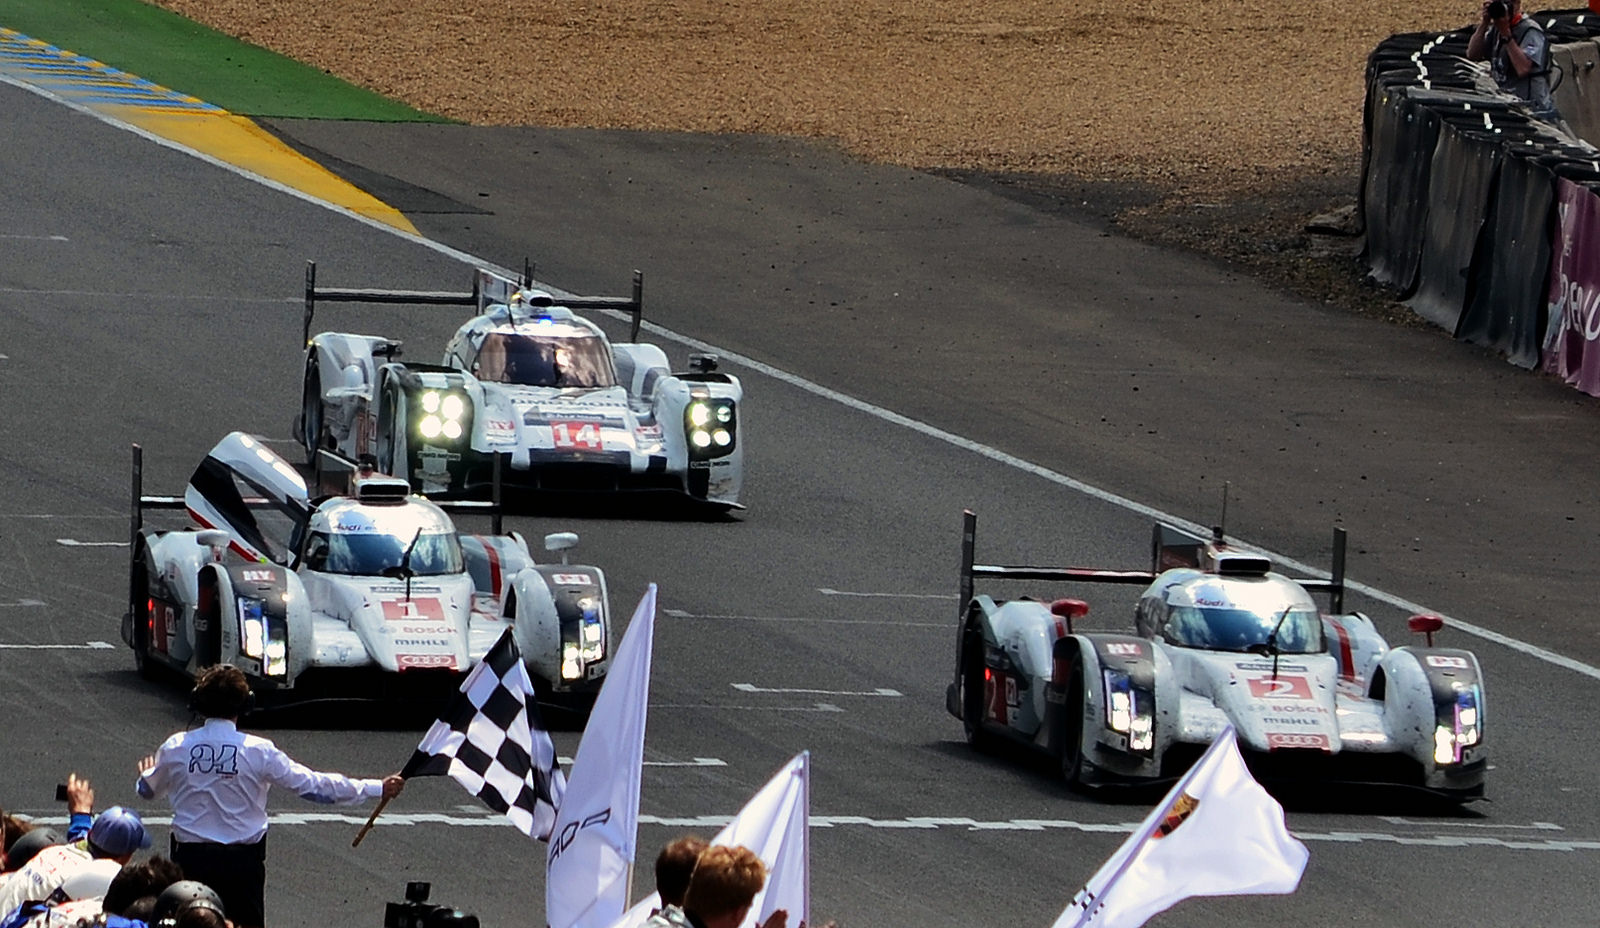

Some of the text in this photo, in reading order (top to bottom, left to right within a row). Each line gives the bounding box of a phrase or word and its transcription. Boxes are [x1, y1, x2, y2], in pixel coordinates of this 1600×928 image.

[553, 423, 601, 448] 14
[397, 602, 429, 619] 1
[1195, 597, 1224, 607] Audi
[1261, 680, 1302, 698] 2
[1272, 705, 1328, 713] BOSCH
